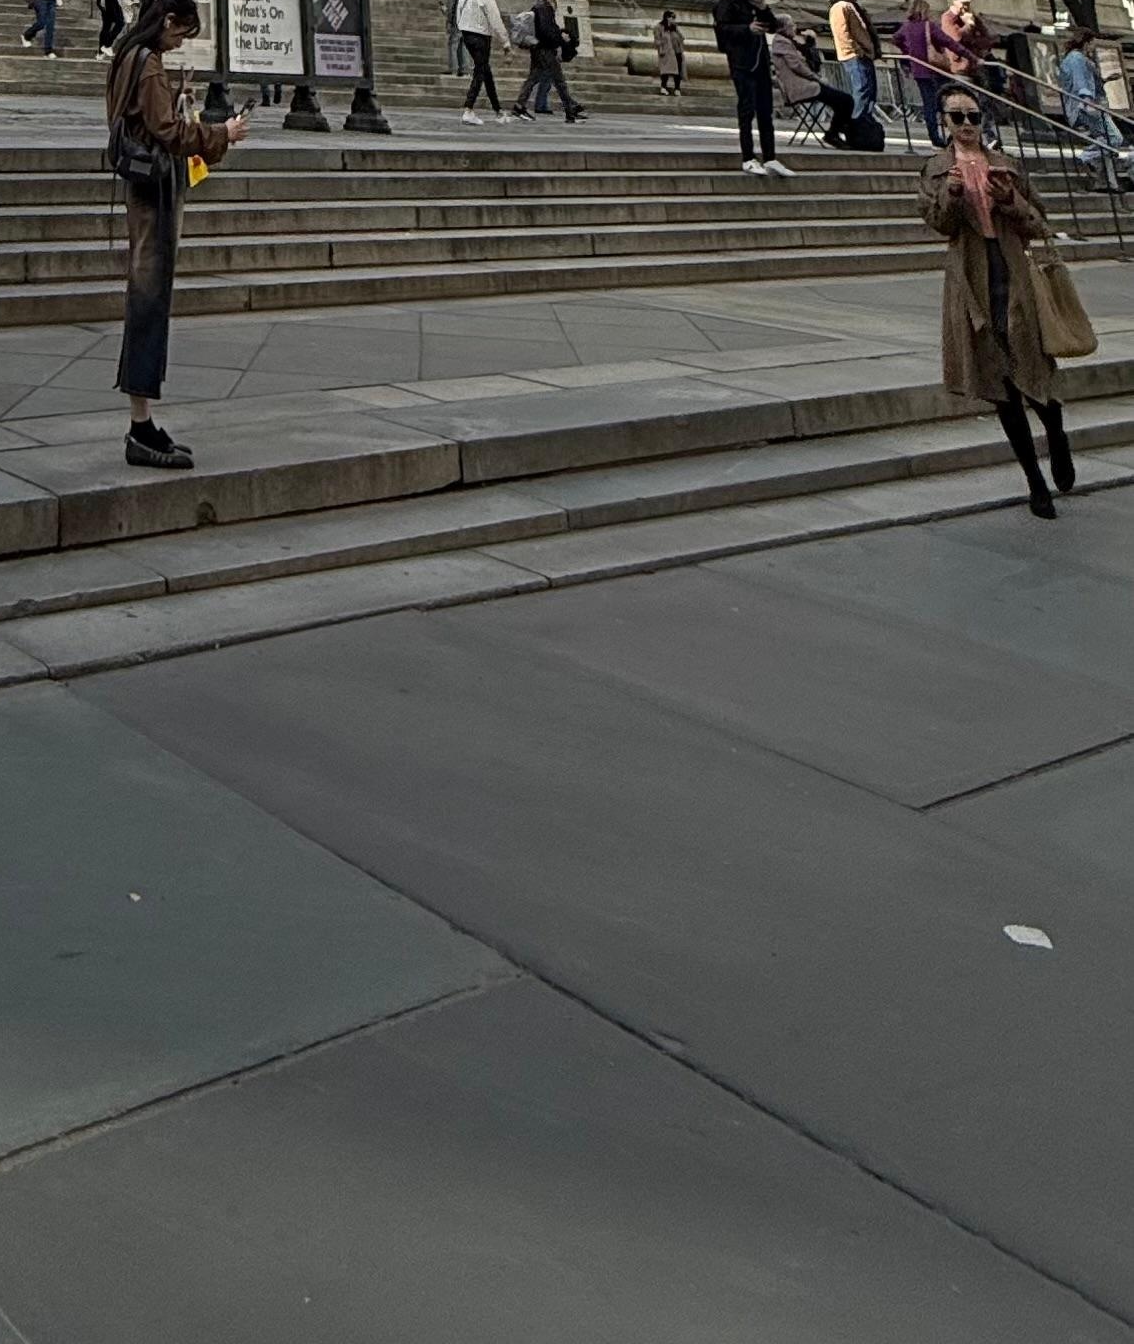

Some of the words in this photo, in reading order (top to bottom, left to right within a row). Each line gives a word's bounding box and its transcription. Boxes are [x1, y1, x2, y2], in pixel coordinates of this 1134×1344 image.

[233, 4, 267, 18] What's
[269, 6, 284, 19] On
[234, 20, 257, 33] Now
[260, 23, 270, 34] at
[235, 35, 252, 50] the
[254, 37, 293, 55] Library!
